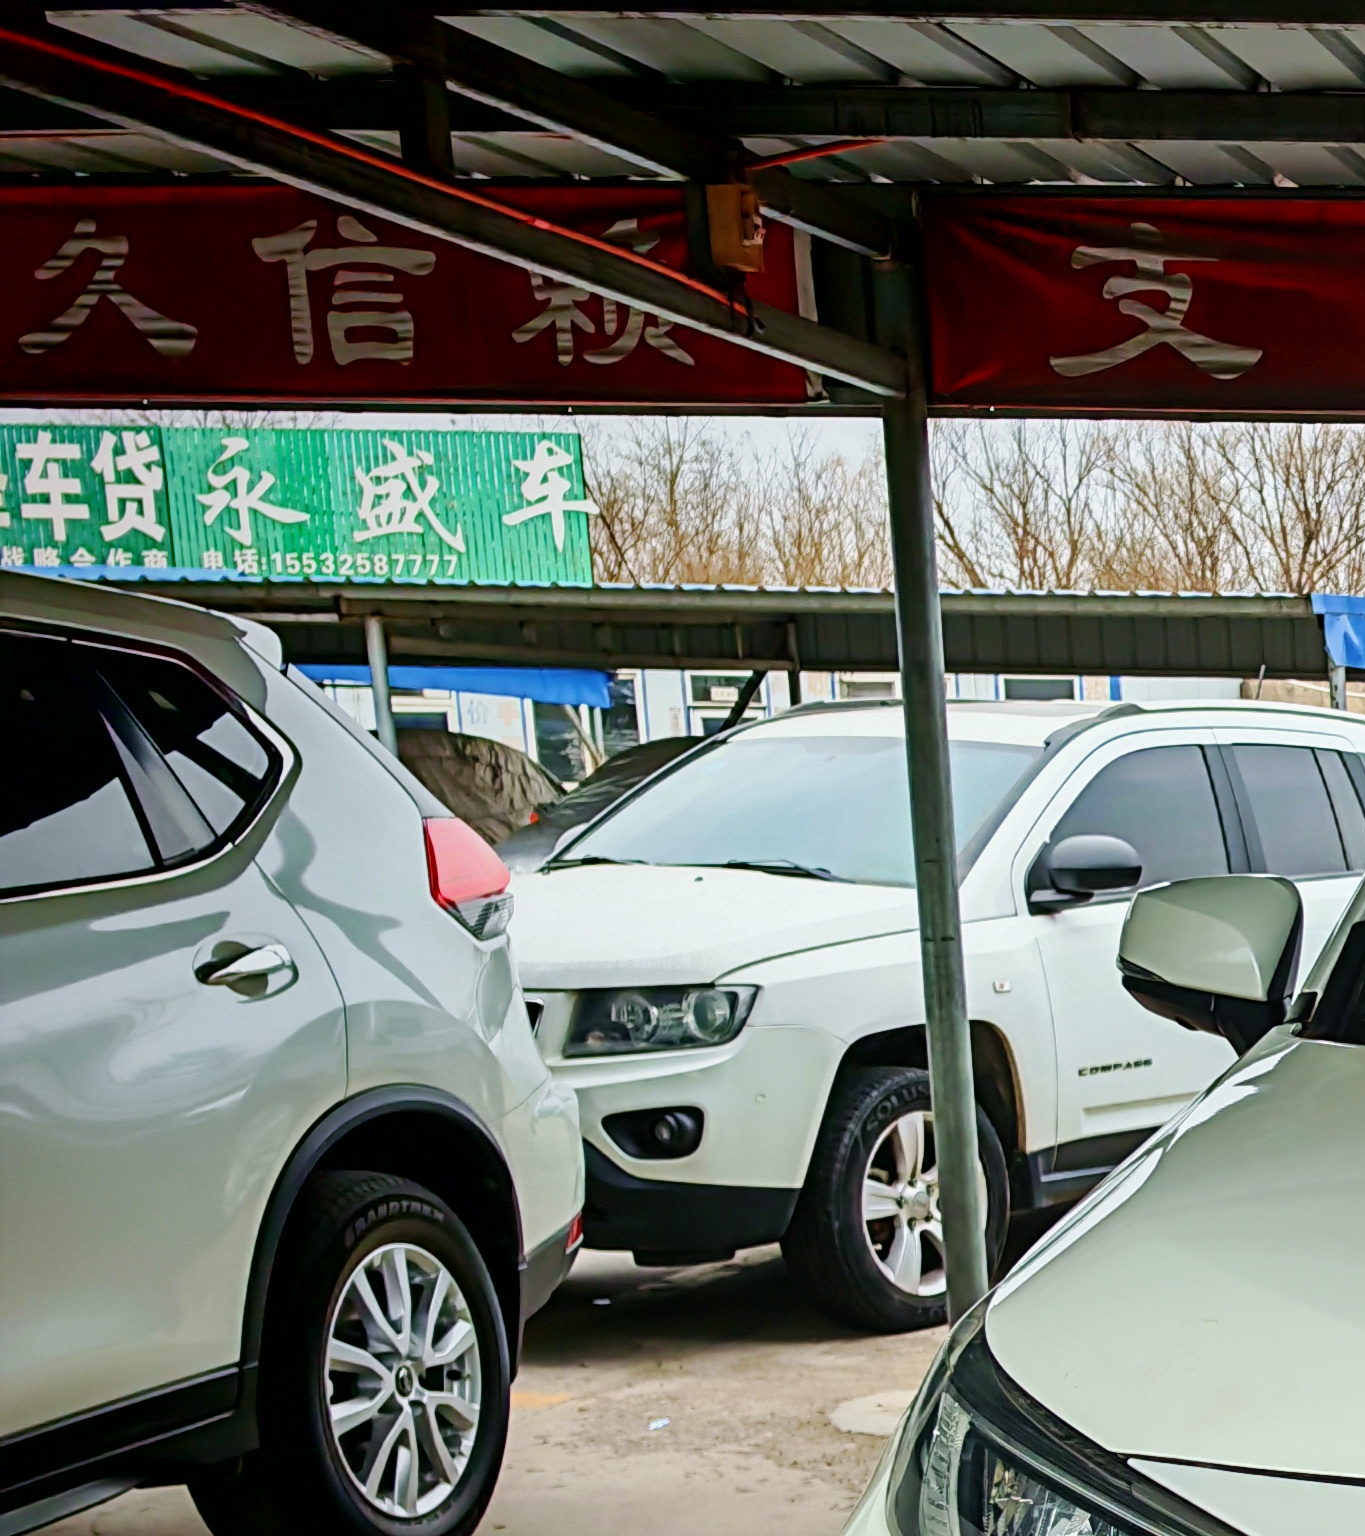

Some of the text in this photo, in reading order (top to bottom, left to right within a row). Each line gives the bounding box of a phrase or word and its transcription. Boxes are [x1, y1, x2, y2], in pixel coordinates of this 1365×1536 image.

[0, 430, 166, 542] 车贷
[197, 437, 600, 554] 永盛车
[1078, 1058, 1152, 1076] COMPASS
